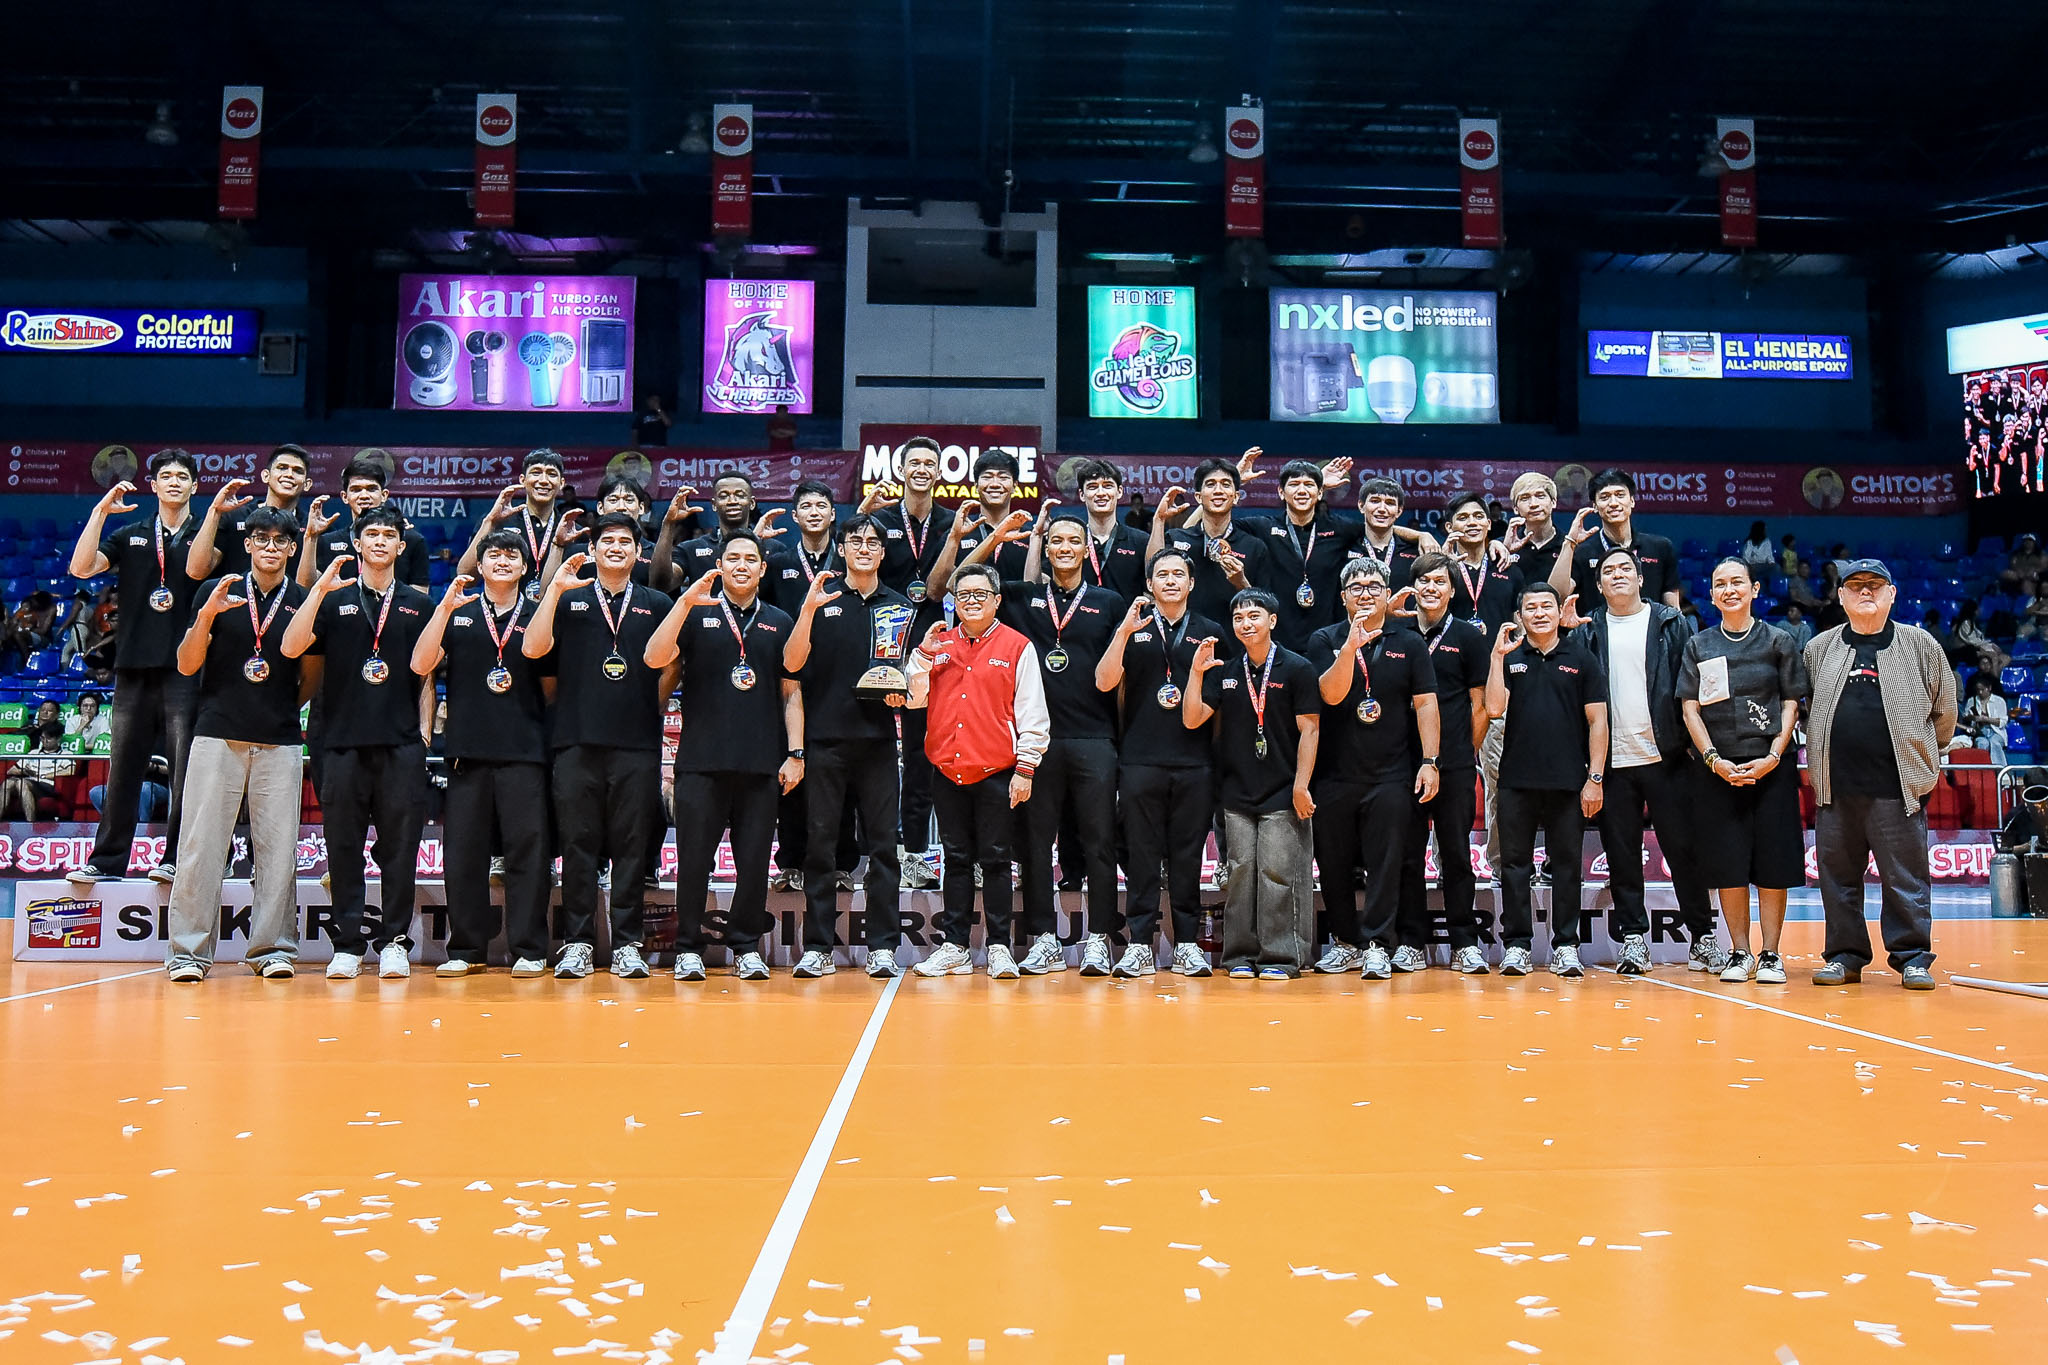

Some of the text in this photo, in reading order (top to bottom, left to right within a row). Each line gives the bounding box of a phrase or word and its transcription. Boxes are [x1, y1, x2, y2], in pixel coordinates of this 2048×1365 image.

[228, 109, 255, 118] Gazz
[482, 117, 510, 125] Gazz
[719, 127, 746, 135] Gazz
[226, 165, 252, 174] Gazz
[481, 172, 509, 181] Gazz
[719, 182, 746, 191] Gazz
[551, 294, 618, 304] TURBO FAN
[729, 283, 788, 299] HOME
[1112, 289, 1176, 306] HOME
[410, 281, 546, 318] Akari
[734, 300, 783, 309] OF THE
[551, 306, 621, 316] AIR COOLER
[1279, 295, 1414, 331] nxled
[1414, 307, 1477, 317] NO POWER?
[54, 317, 116, 341] Shine
[137, 314, 233, 335] Colorful
[1414, 317, 1492, 327] NO PROBLEM!
[135, 335, 232, 349] PROTECTION
[1604, 344, 1646, 356] BOSTIK
[1725, 341, 1749, 358] EL
[1754, 341, 1847, 359] HENERAL
[1105, 351, 1157, 370] nxled
[1725, 359, 1847, 373] ALL-PURPOSE EPOXY
[728, 370, 786, 388] Akari
[1095, 358, 1192, 388] CHAMELEONS
[146, 454, 257, 473] CTOK'S
[403, 457, 514, 475] CHITOK'S
[660, 458, 770, 479] CHITOK'S
[1633, 472, 1706, 491] ITOK'S
[1851, 474, 1954, 494] CHITOK'S
[451, 498, 467, 517] A
[989, 658, 1010, 669] Cignal
[1558, 665, 1579, 675] Cignal
[64, 930, 97, 947] Turf
